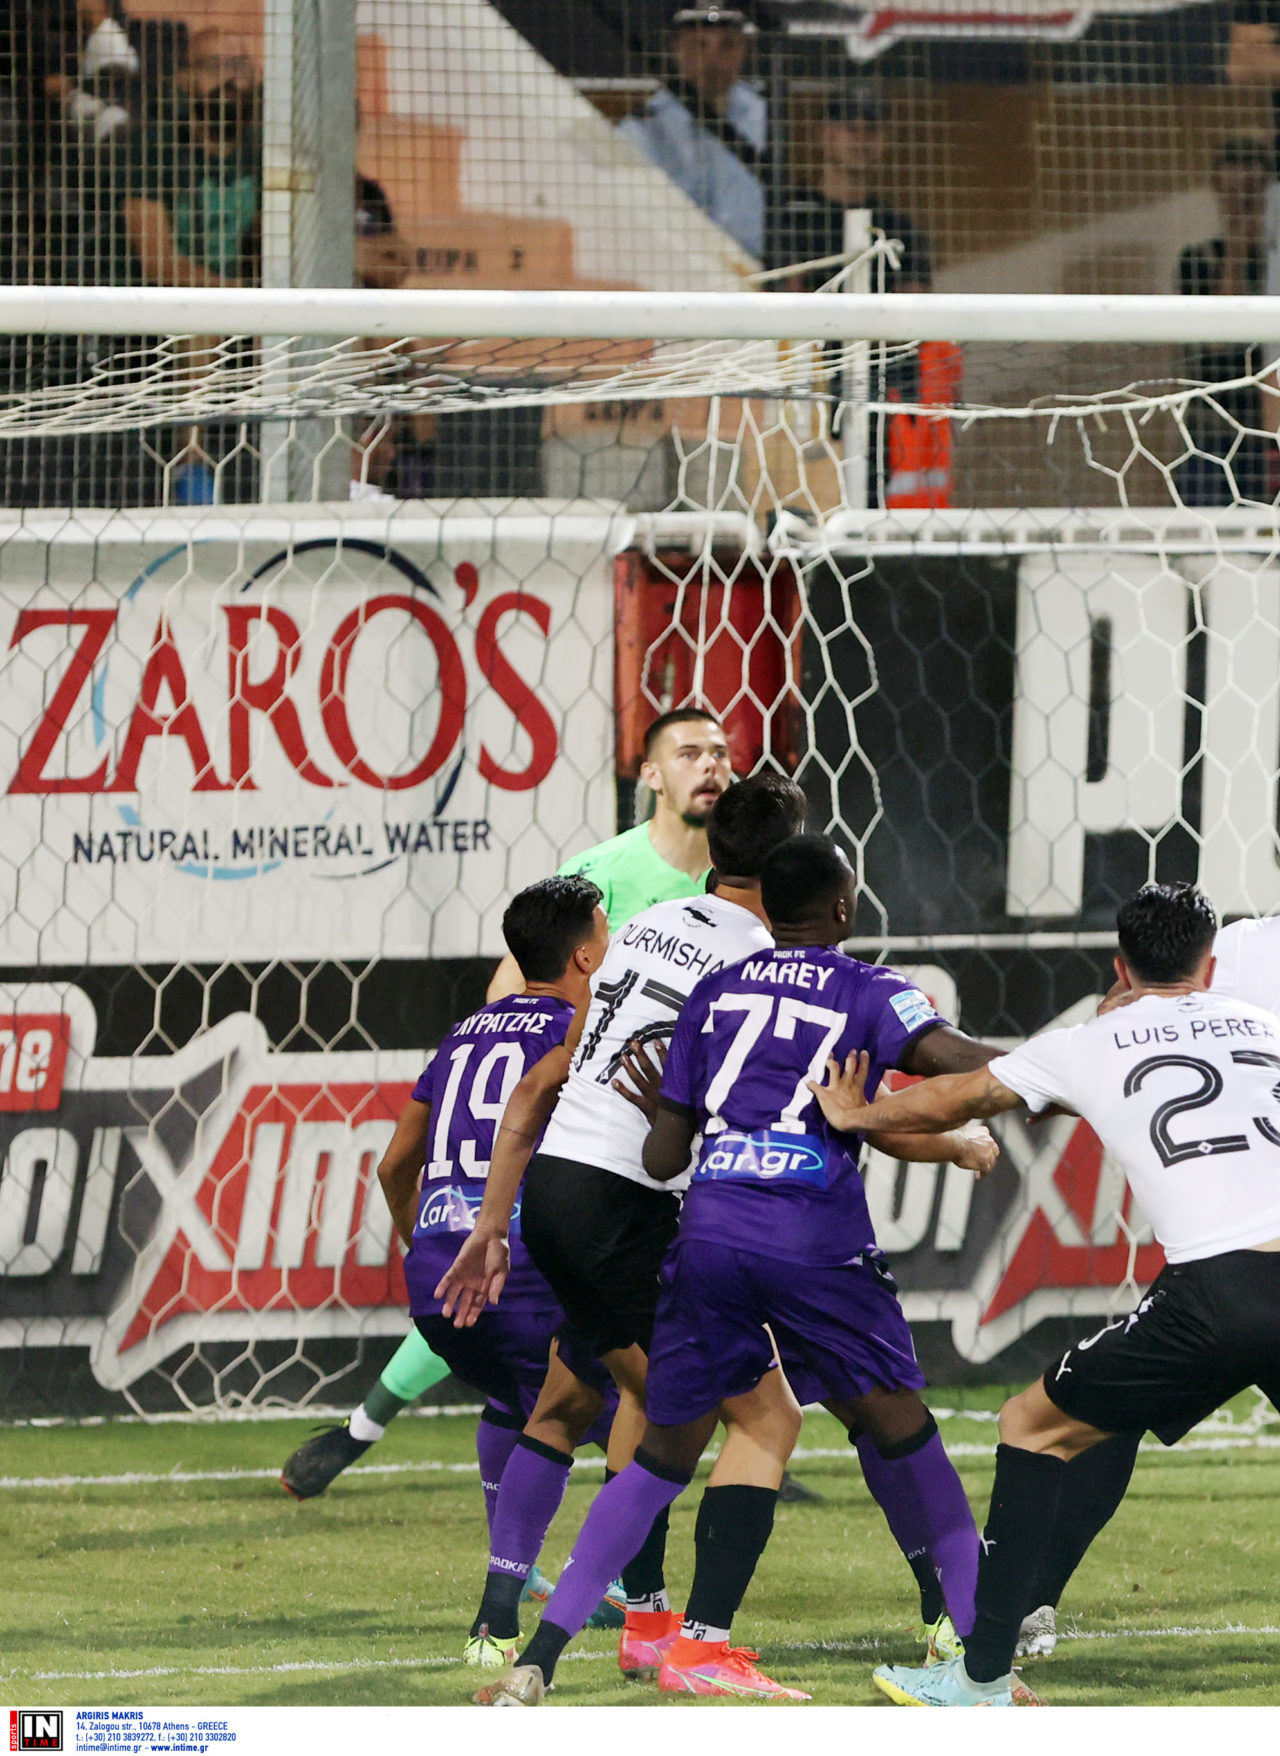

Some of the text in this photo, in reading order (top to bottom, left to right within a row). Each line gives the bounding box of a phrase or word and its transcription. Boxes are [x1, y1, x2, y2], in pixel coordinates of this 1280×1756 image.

[6, 561, 559, 795] ZARO'S
[72, 820, 491, 863] NATURAL MINERAL WATER
[741, 960, 835, 991] NAREY
[701, 992, 848, 1136] 77
[1114, 1025, 1179, 1050] LUIS
[428, 1042, 525, 1180] 19
